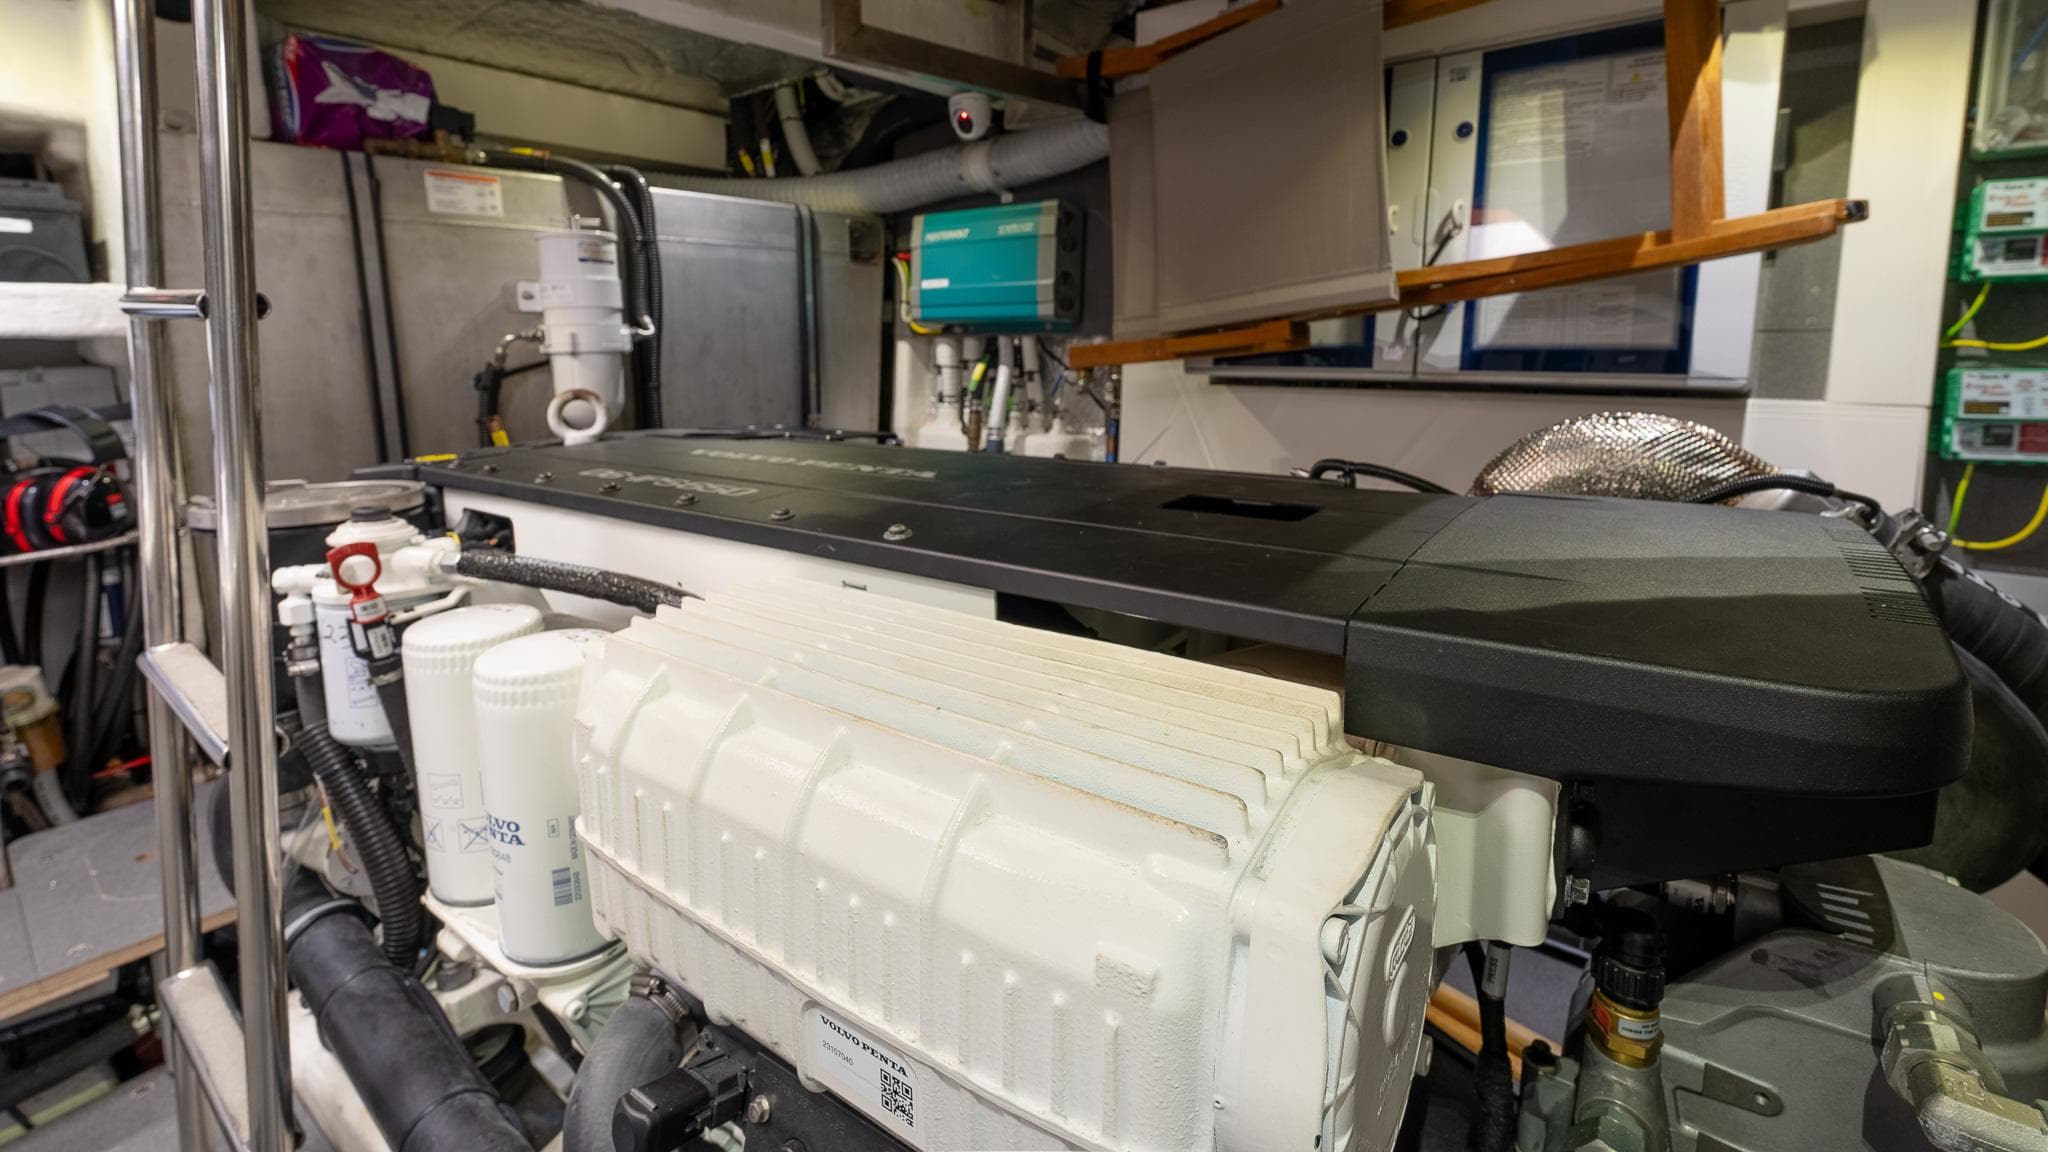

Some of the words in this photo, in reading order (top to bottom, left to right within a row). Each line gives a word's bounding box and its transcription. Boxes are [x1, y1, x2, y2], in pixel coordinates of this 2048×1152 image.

[487, 812, 520, 833] LVO
[820, 1014, 861, 1046] VOLVO
[860, 1041, 908, 1078] PENTA
